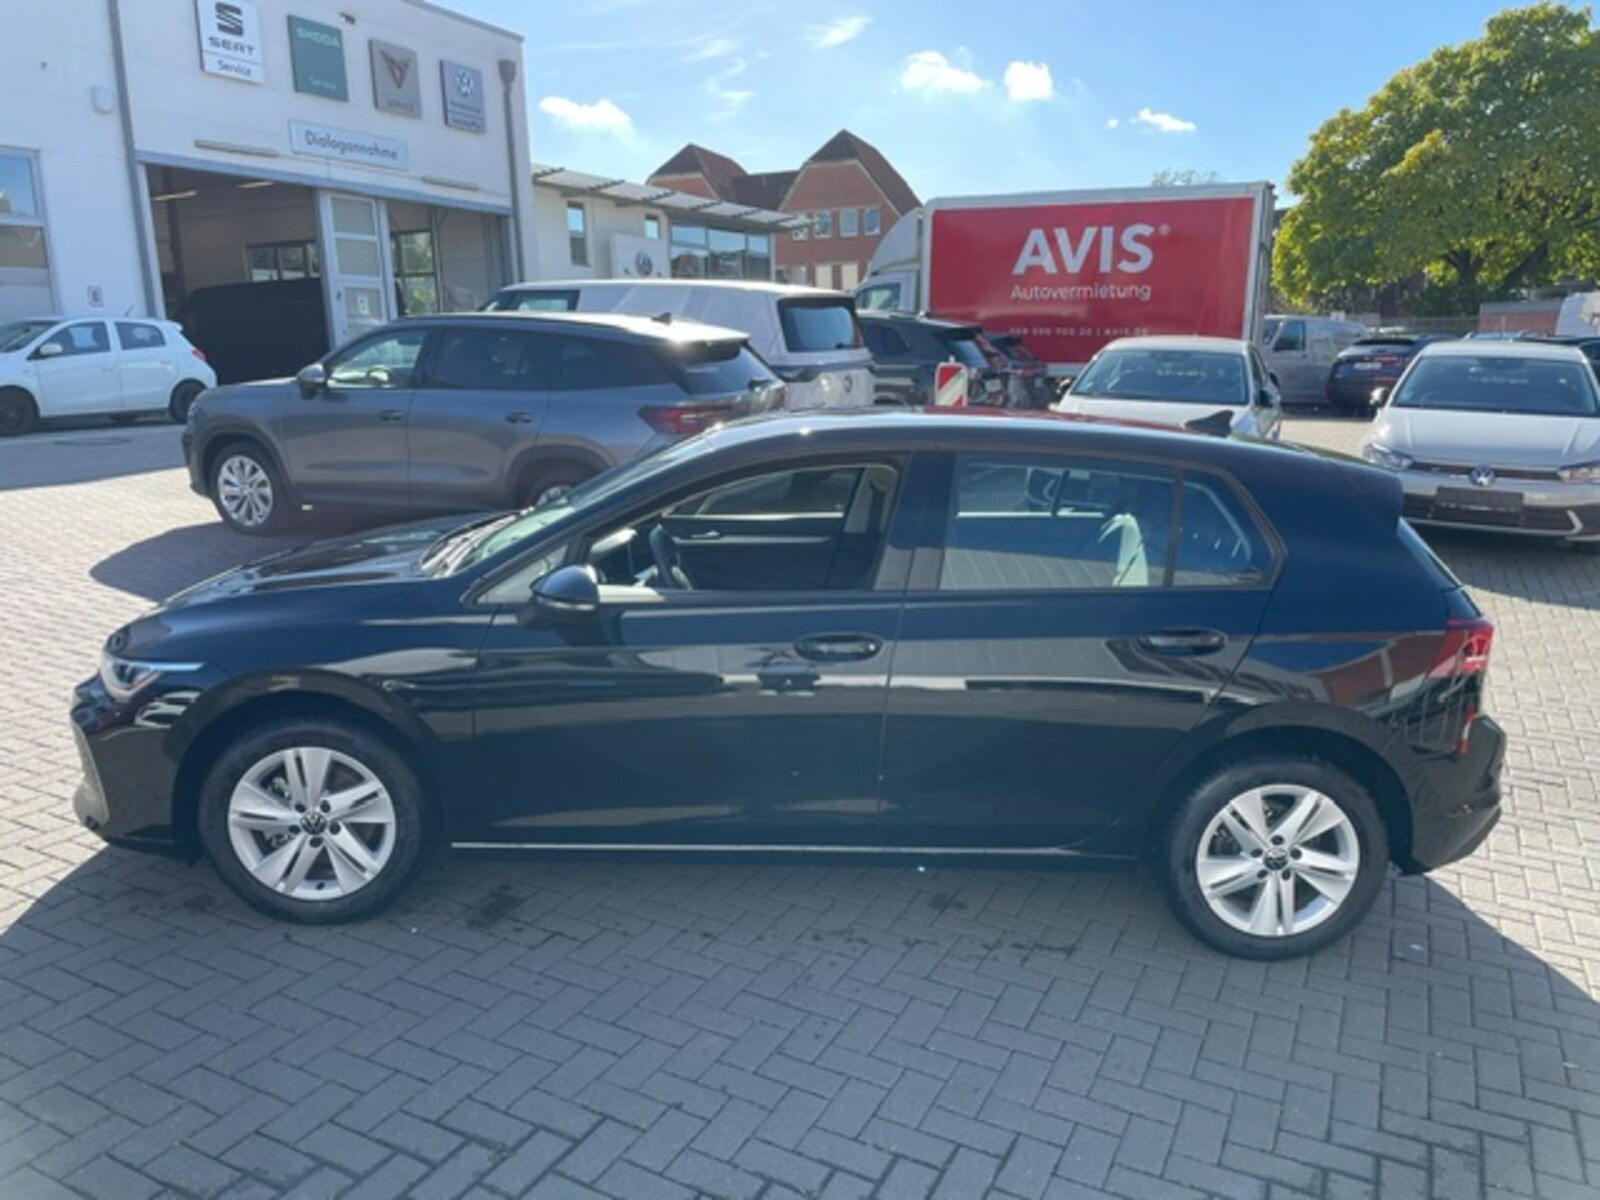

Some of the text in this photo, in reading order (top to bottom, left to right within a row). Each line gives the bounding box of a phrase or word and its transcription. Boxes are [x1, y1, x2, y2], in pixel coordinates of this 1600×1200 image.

[207, 36, 256, 55] SEAT
[217, 59, 252, 77] Service
[304, 129, 398, 160] Dialogannahme
[1010, 282, 1152, 301] Autovermietung
